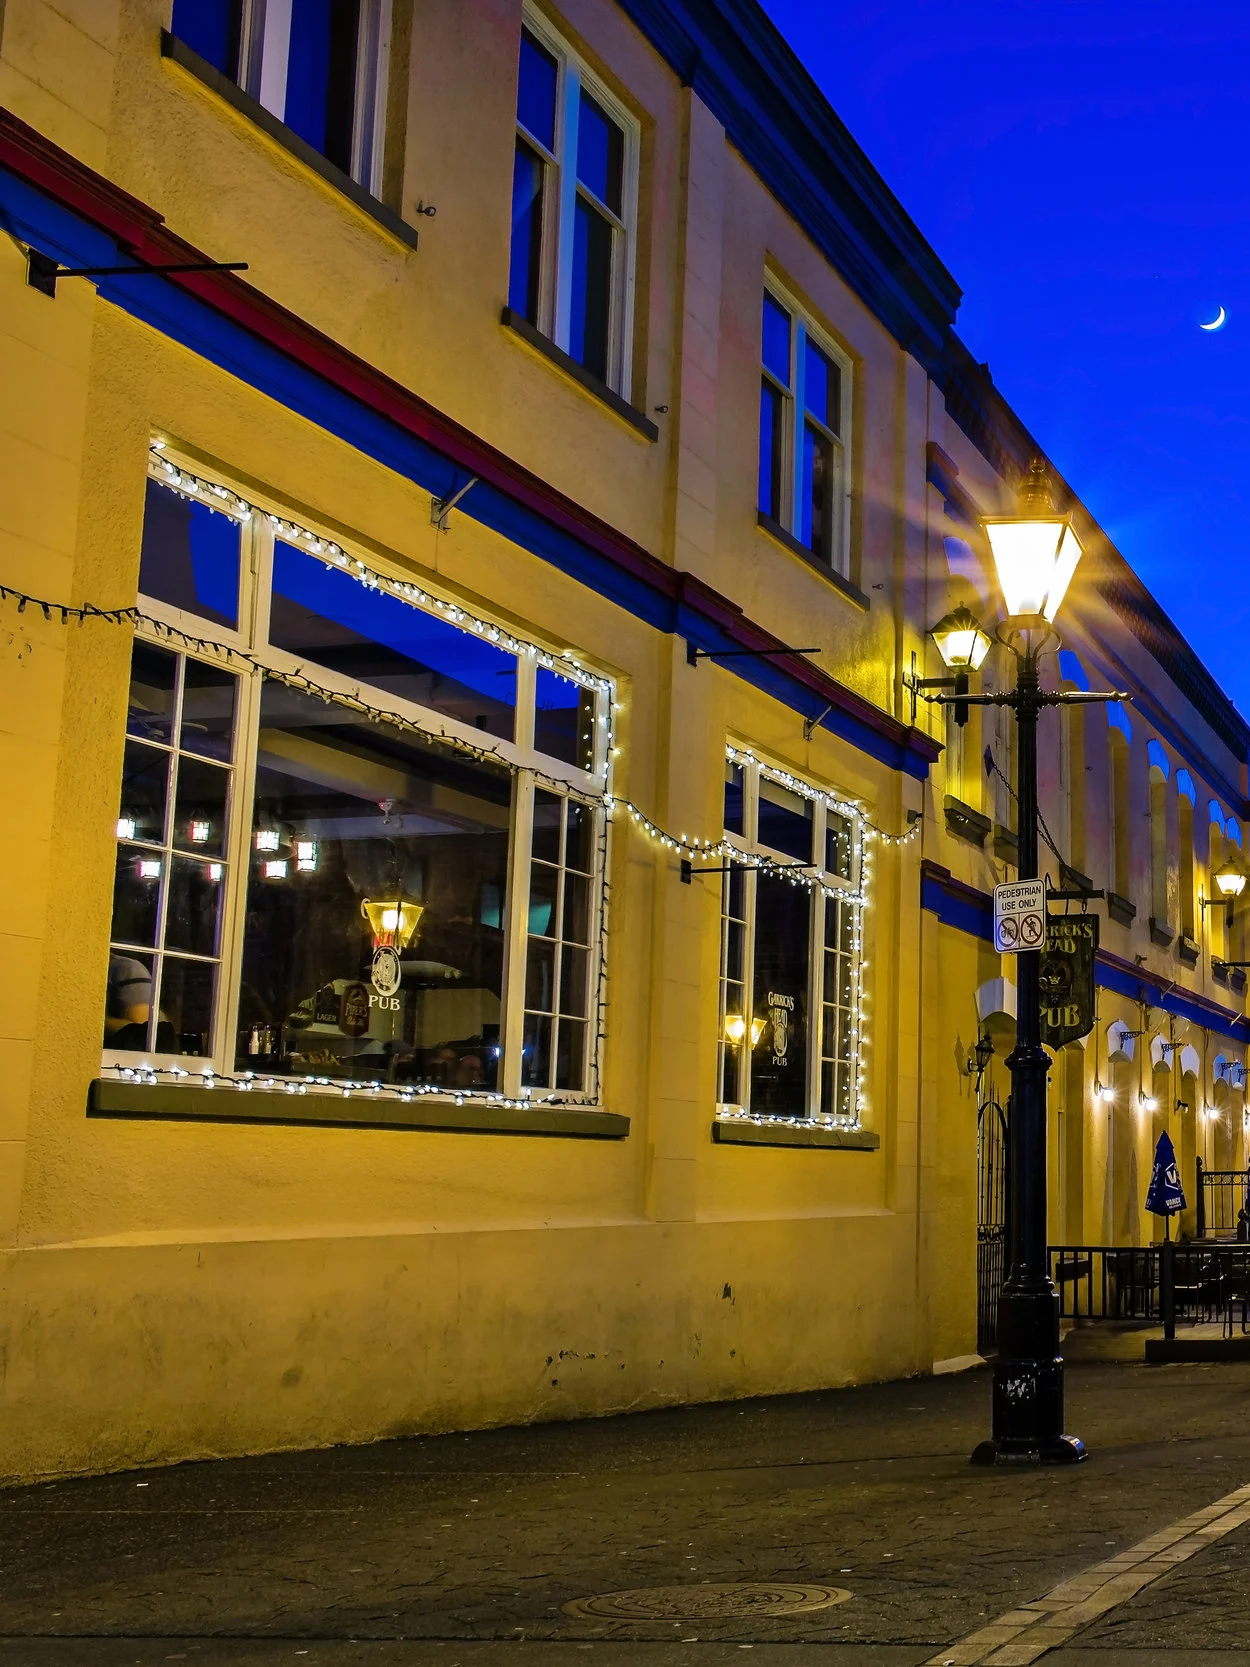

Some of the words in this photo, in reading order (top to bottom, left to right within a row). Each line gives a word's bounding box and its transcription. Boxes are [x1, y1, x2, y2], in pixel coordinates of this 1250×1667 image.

[997, 885, 1042, 900] PEDESTRIAN
[1001, 900, 1016, 911] USE
[1018, 898, 1037, 909] ONLY
[368, 994, 401, 1011] PUB
[316, 1013, 337, 1022] LAGER
[772, 1055, 788, 1067] PUB
